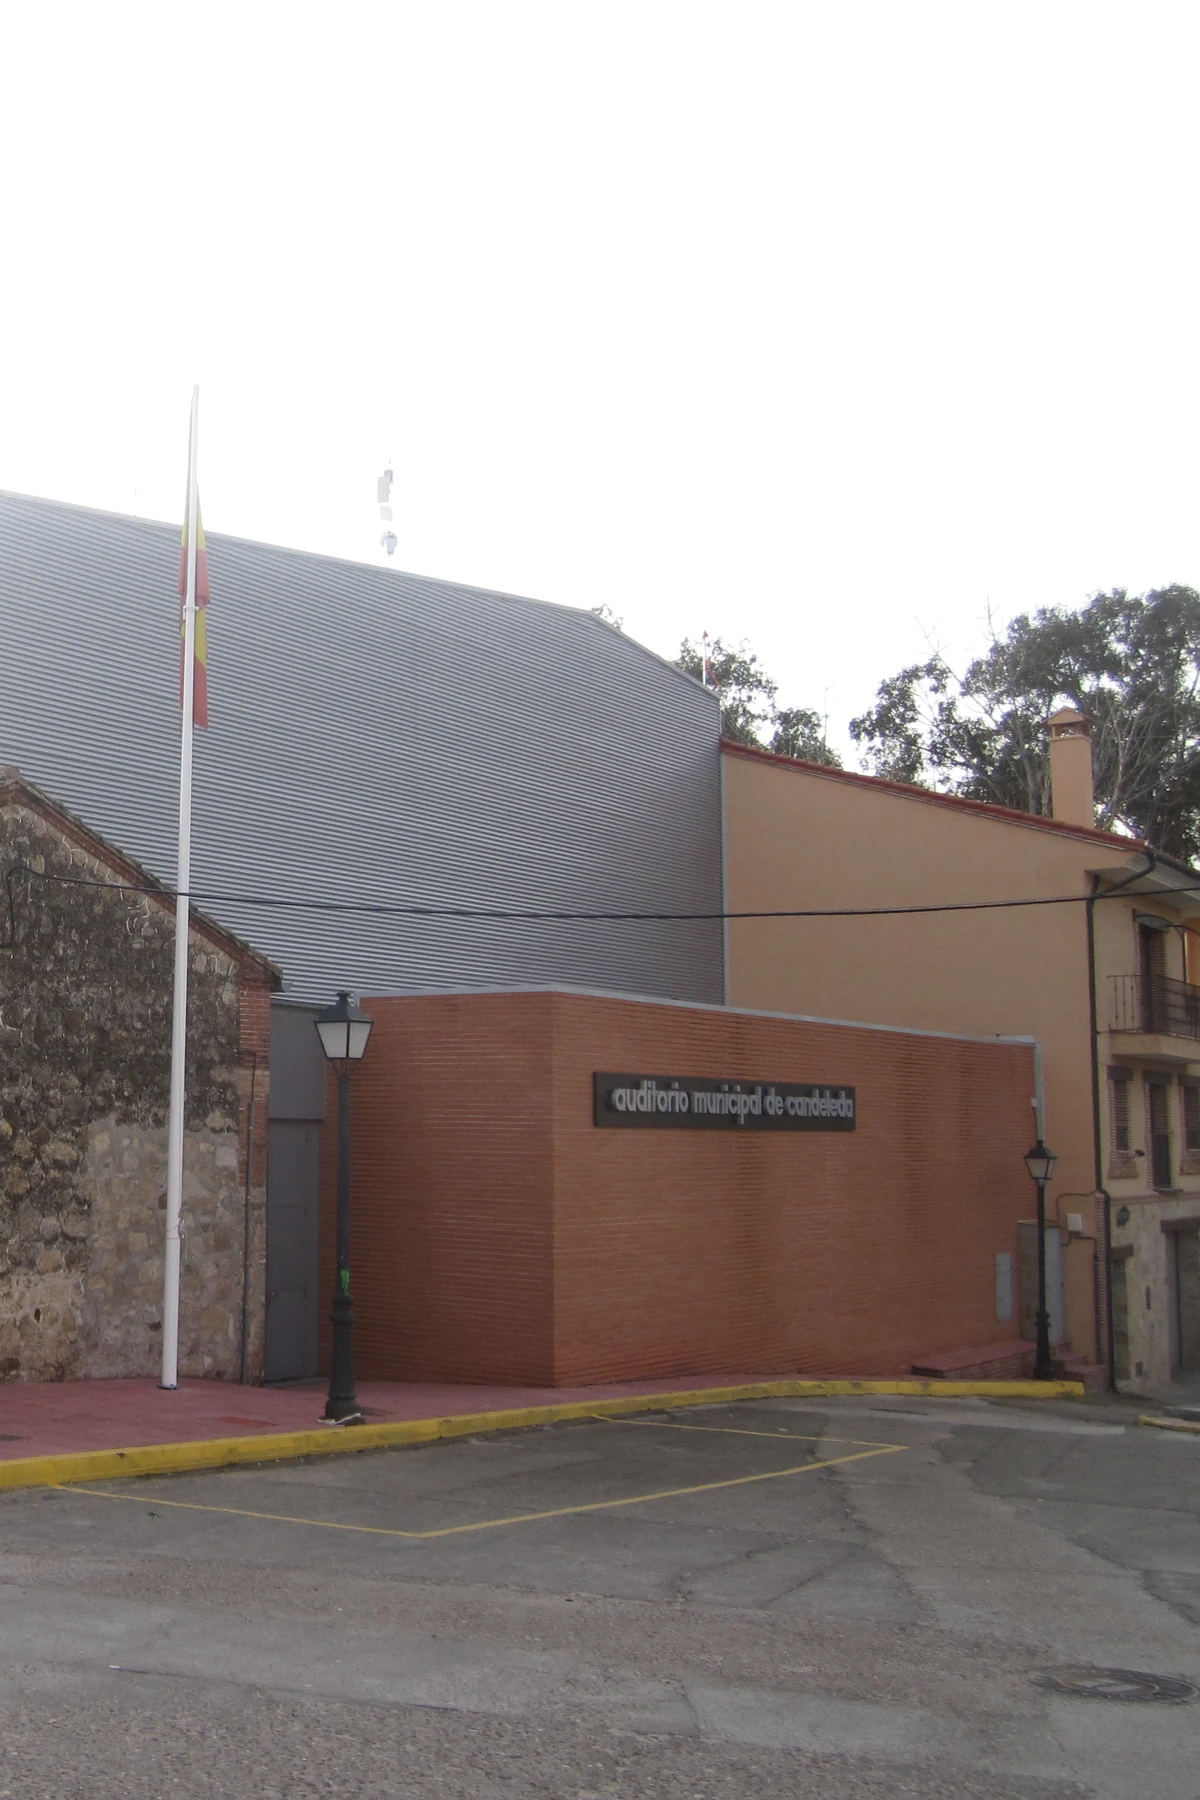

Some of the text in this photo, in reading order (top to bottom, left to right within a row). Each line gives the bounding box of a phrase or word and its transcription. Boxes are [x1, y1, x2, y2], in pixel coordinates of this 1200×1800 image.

[612, 1080, 853, 1125] auditorio municipal de candeleda
